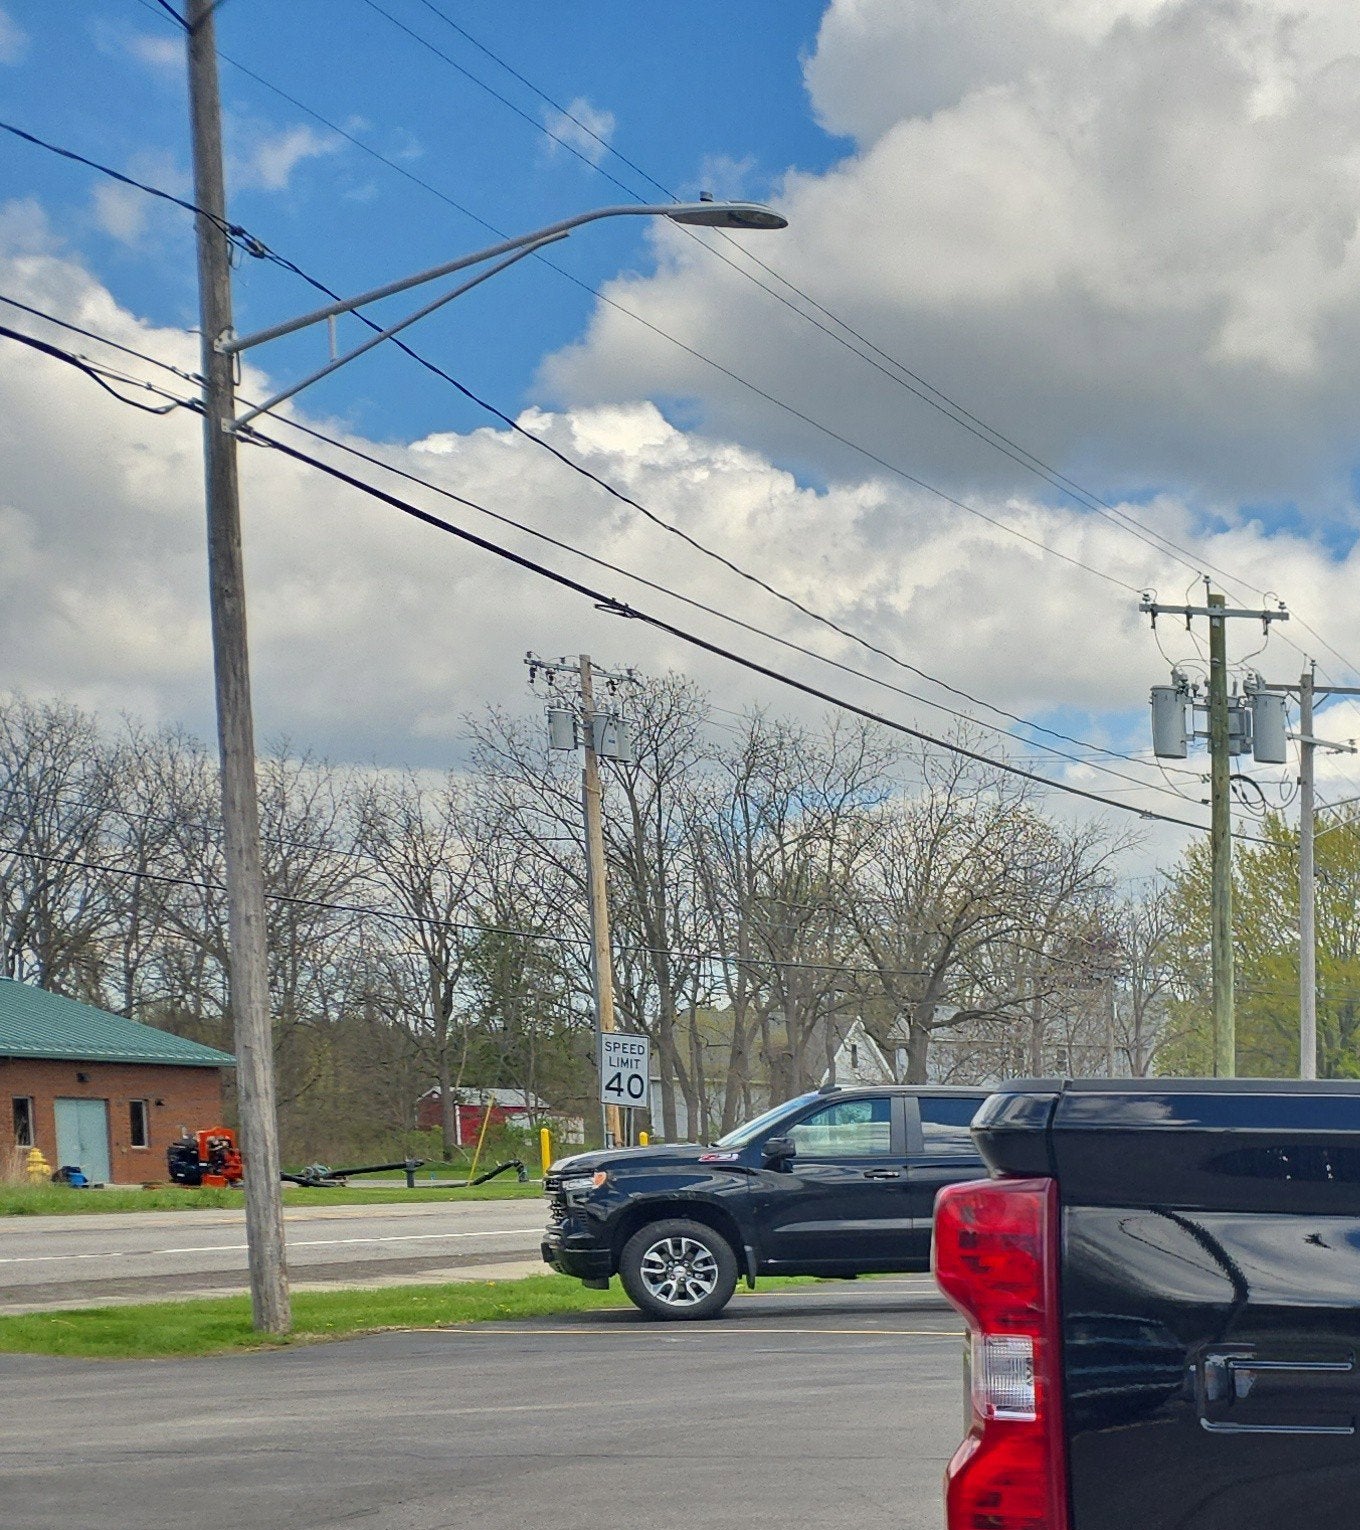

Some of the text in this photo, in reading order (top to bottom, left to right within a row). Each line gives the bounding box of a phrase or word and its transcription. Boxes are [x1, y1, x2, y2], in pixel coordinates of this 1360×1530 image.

[605, 1041, 645, 1055] SPEED
[609, 1056, 641, 1069] LIMIT
[605, 1072, 644, 1099] 40
